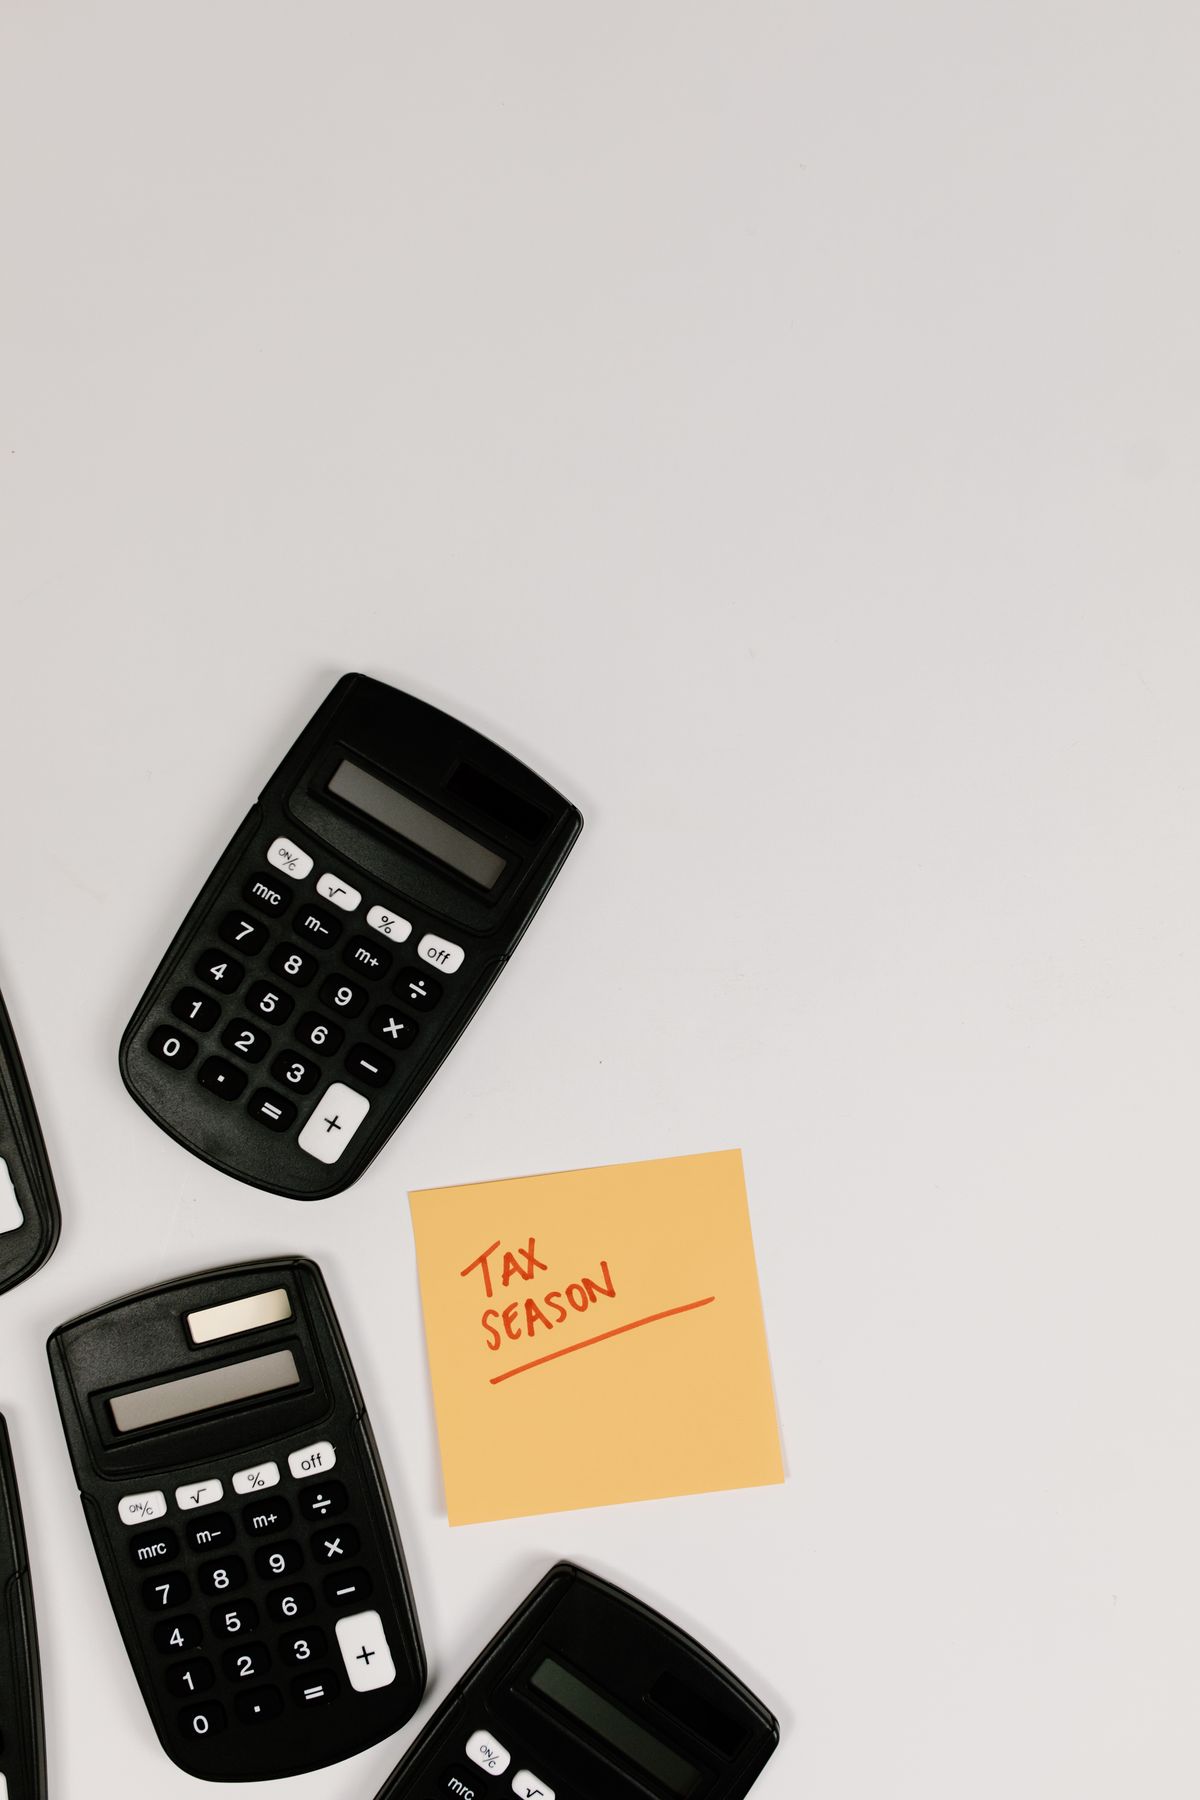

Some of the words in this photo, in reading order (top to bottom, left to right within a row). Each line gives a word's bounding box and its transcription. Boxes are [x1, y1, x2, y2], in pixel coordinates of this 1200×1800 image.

[253, 883, 280, 904] mrc
[236, 922, 254, 940] 7
[284, 955, 302, 974] 8
[335, 987, 352, 1005] 9
[427, 947, 450, 965] off
[210, 964, 227, 980] 4
[260, 993, 278, 1012] 5
[311, 1026, 328, 1044] 6
[163, 1038, 180, 1056] 0
[190, 1002, 202, 1018] 1
[235, 1031, 254, 1052] 2
[287, 1064, 304, 1082] 3
[460, 1237, 547, 1297] TAX
[481, 1261, 616, 1351] SEASON
[301, 1453, 323, 1471] off
[138, 1543, 166, 1559] mrc
[156, 1584, 169, 1604] 7
[213, 1570, 229, 1588] 8
[269, 1554, 285, 1573] 9
[170, 1628, 184, 1646] 4
[226, 1612, 240, 1631] 5
[282, 1597, 297, 1615] 6
[183, 1672, 194, 1690] 1
[237, 1656, 254, 1676] 2
[294, 1640, 310, 1659] 3
[193, 1716, 208, 1733] 0
[448, 1777, 475, 1800] mrc
